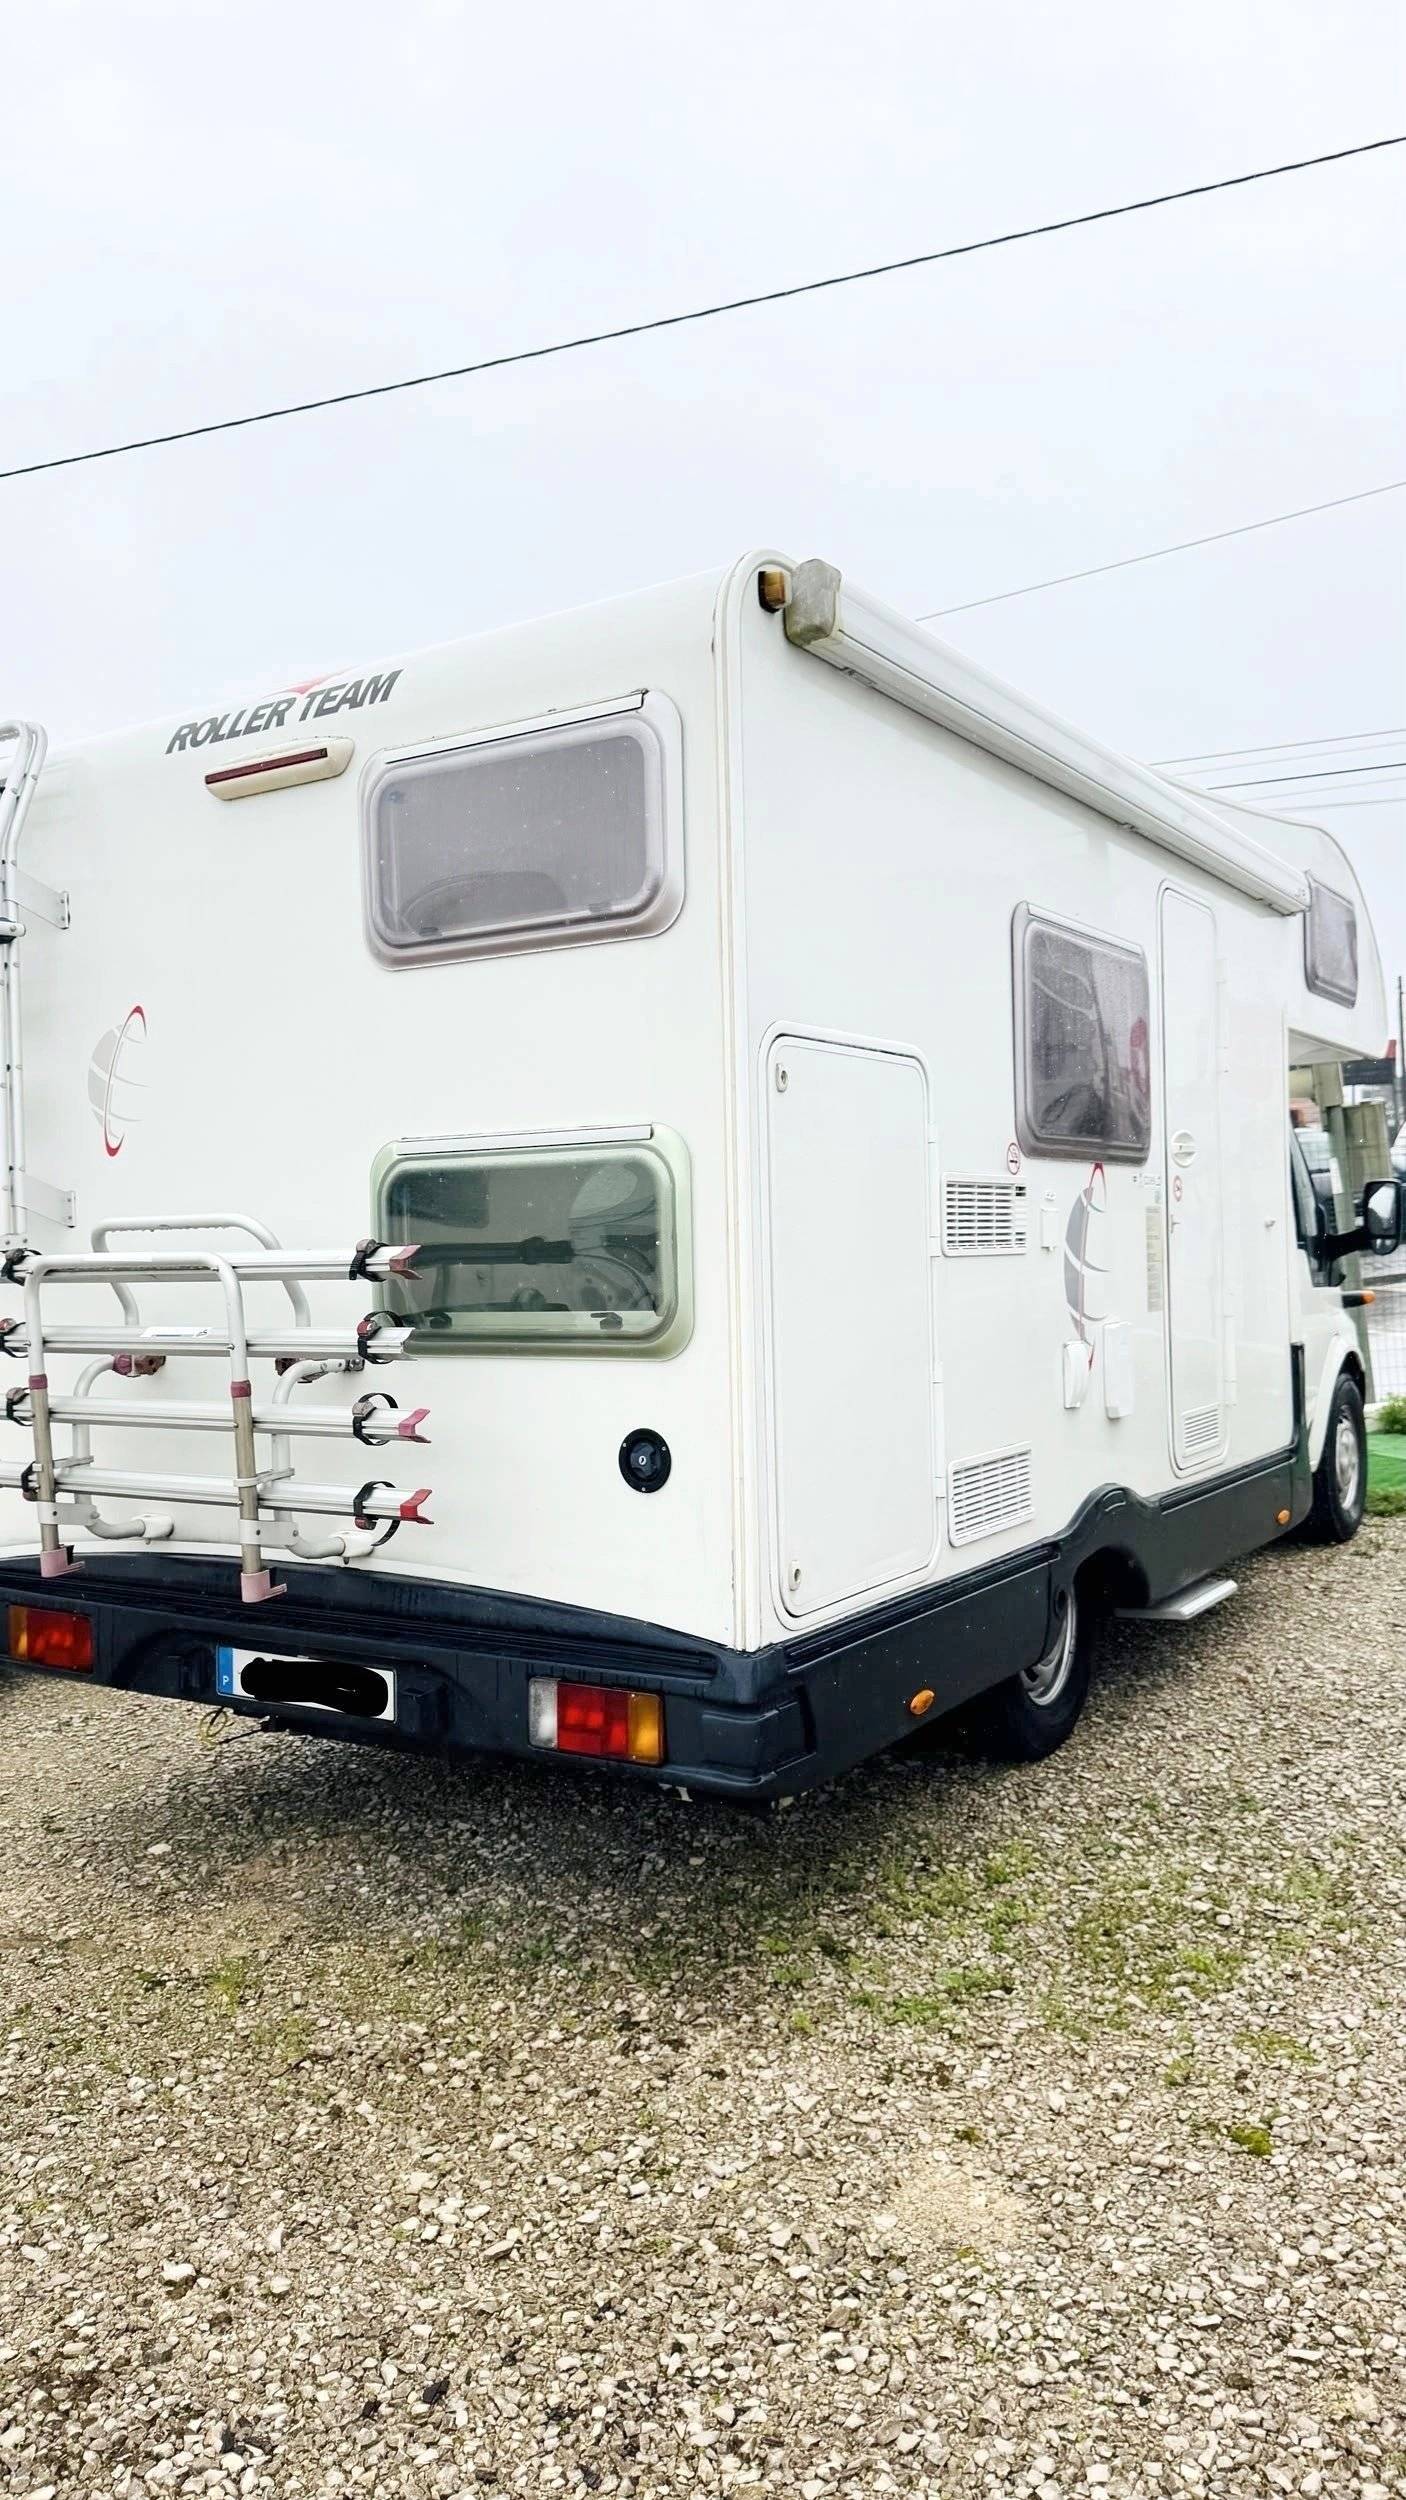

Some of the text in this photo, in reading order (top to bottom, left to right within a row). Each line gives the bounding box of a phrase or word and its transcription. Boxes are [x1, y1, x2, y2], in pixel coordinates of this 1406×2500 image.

[165, 669, 404, 755] ROLLER TEAM
[222, 1675, 230, 1686] P
